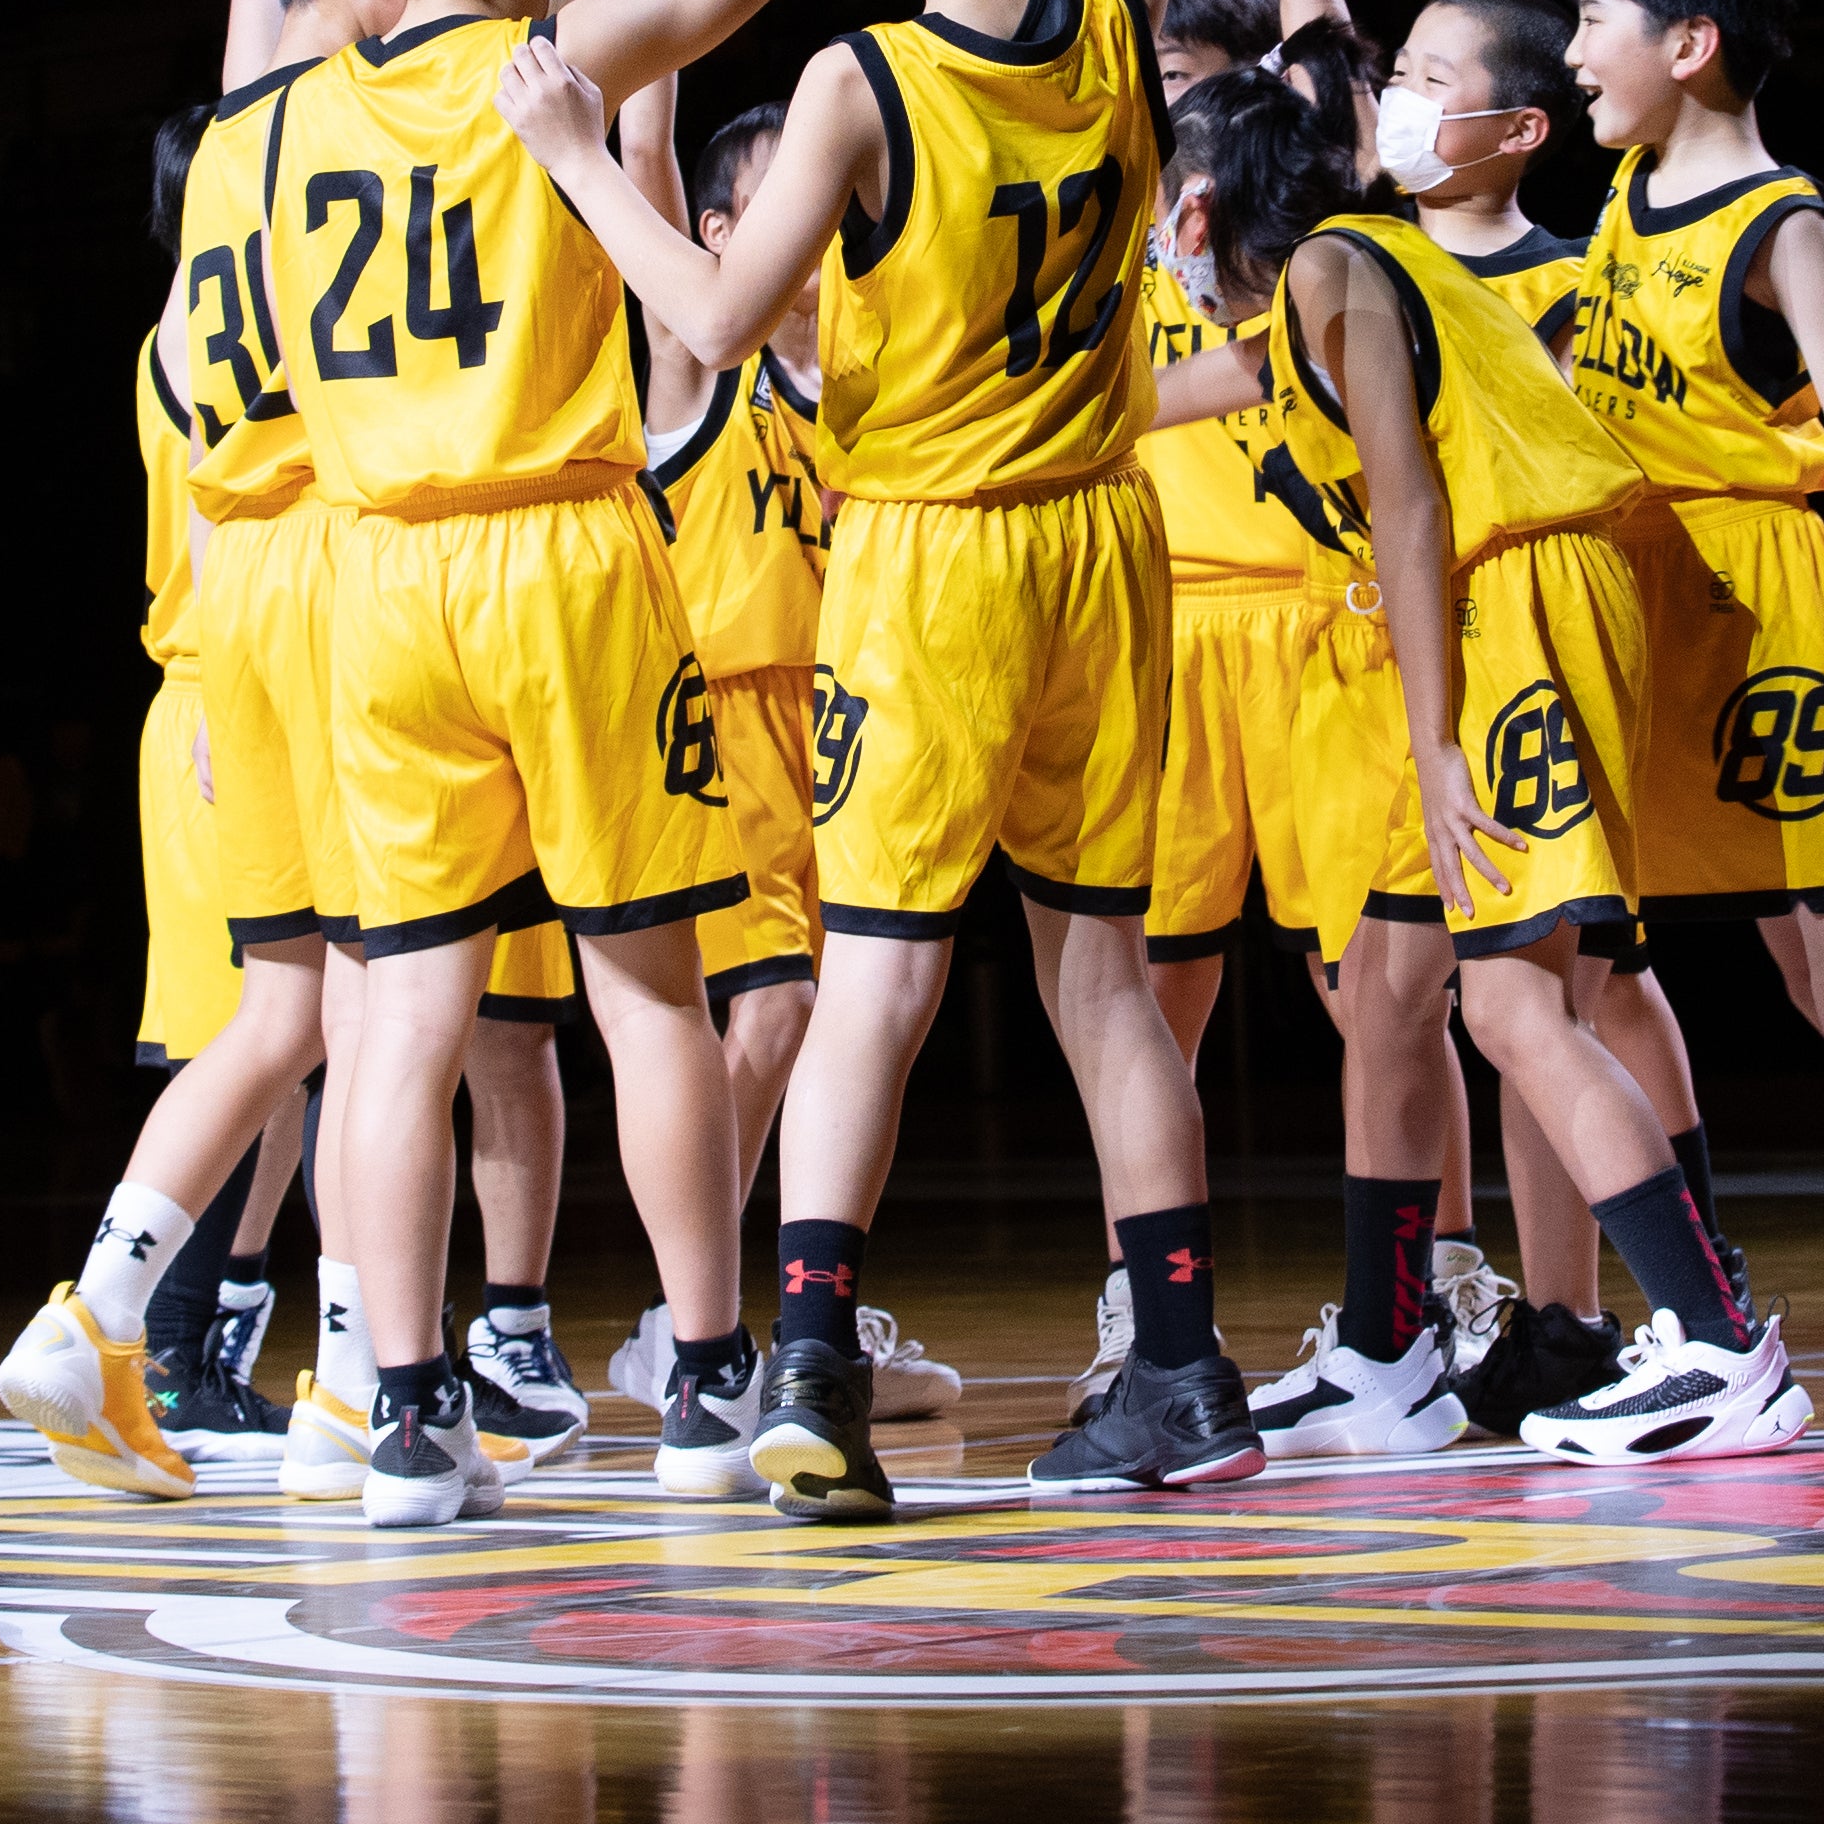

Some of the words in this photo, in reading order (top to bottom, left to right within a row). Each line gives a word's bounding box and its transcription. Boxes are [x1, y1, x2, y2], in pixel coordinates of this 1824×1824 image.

[306, 164, 505, 382] 24
[988, 154, 1124, 378] 12
[1573, 295, 1687, 411] ELLOW
[664, 667, 724, 796] 8
